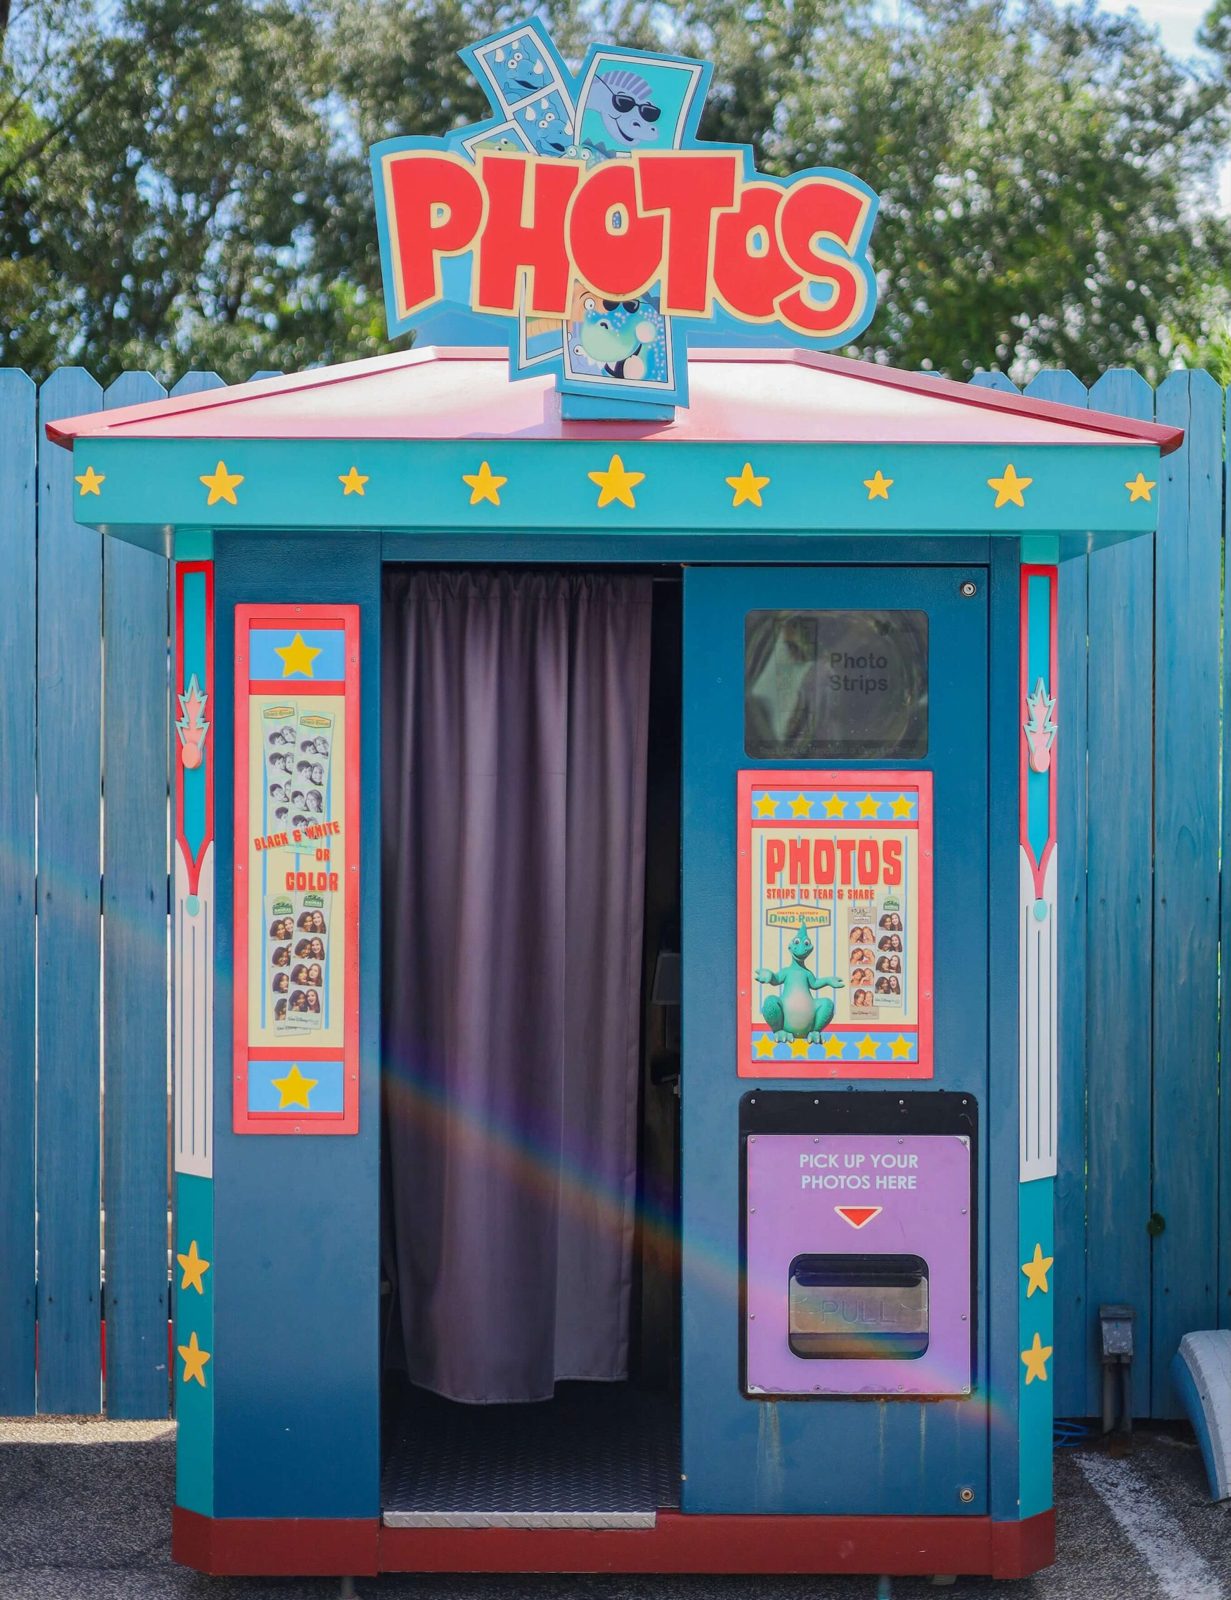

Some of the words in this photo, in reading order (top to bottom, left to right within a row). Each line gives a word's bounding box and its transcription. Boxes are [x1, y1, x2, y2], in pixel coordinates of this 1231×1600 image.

[386, 152, 868, 334] PHOTOS
[830, 653, 888, 669] Photo
[830, 675, 888, 694] Strips
[254, 832, 289, 851] BLACK
[293, 829, 302, 843] &
[306, 821, 340, 839] WHITE
[316, 848, 330, 861] OR
[766, 839, 903, 886] PHOTOS
[286, 872, 338, 892] COLOR
[766, 888, 796, 899] STRIPS
[800, 888, 809, 899] TO
[813, 888, 833, 900] TEAR
[837, 889, 844, 900] &
[848, 888, 875, 900] SHARE
[800, 1154, 839, 1168] PICK
[844, 1154, 865, 1168] UP
[871, 1154, 918, 1169] YOUR
[801, 1174, 870, 1189] PHOTOS
[876, 1175, 917, 1189] HERE
[822, 1300, 897, 1323] PULL
